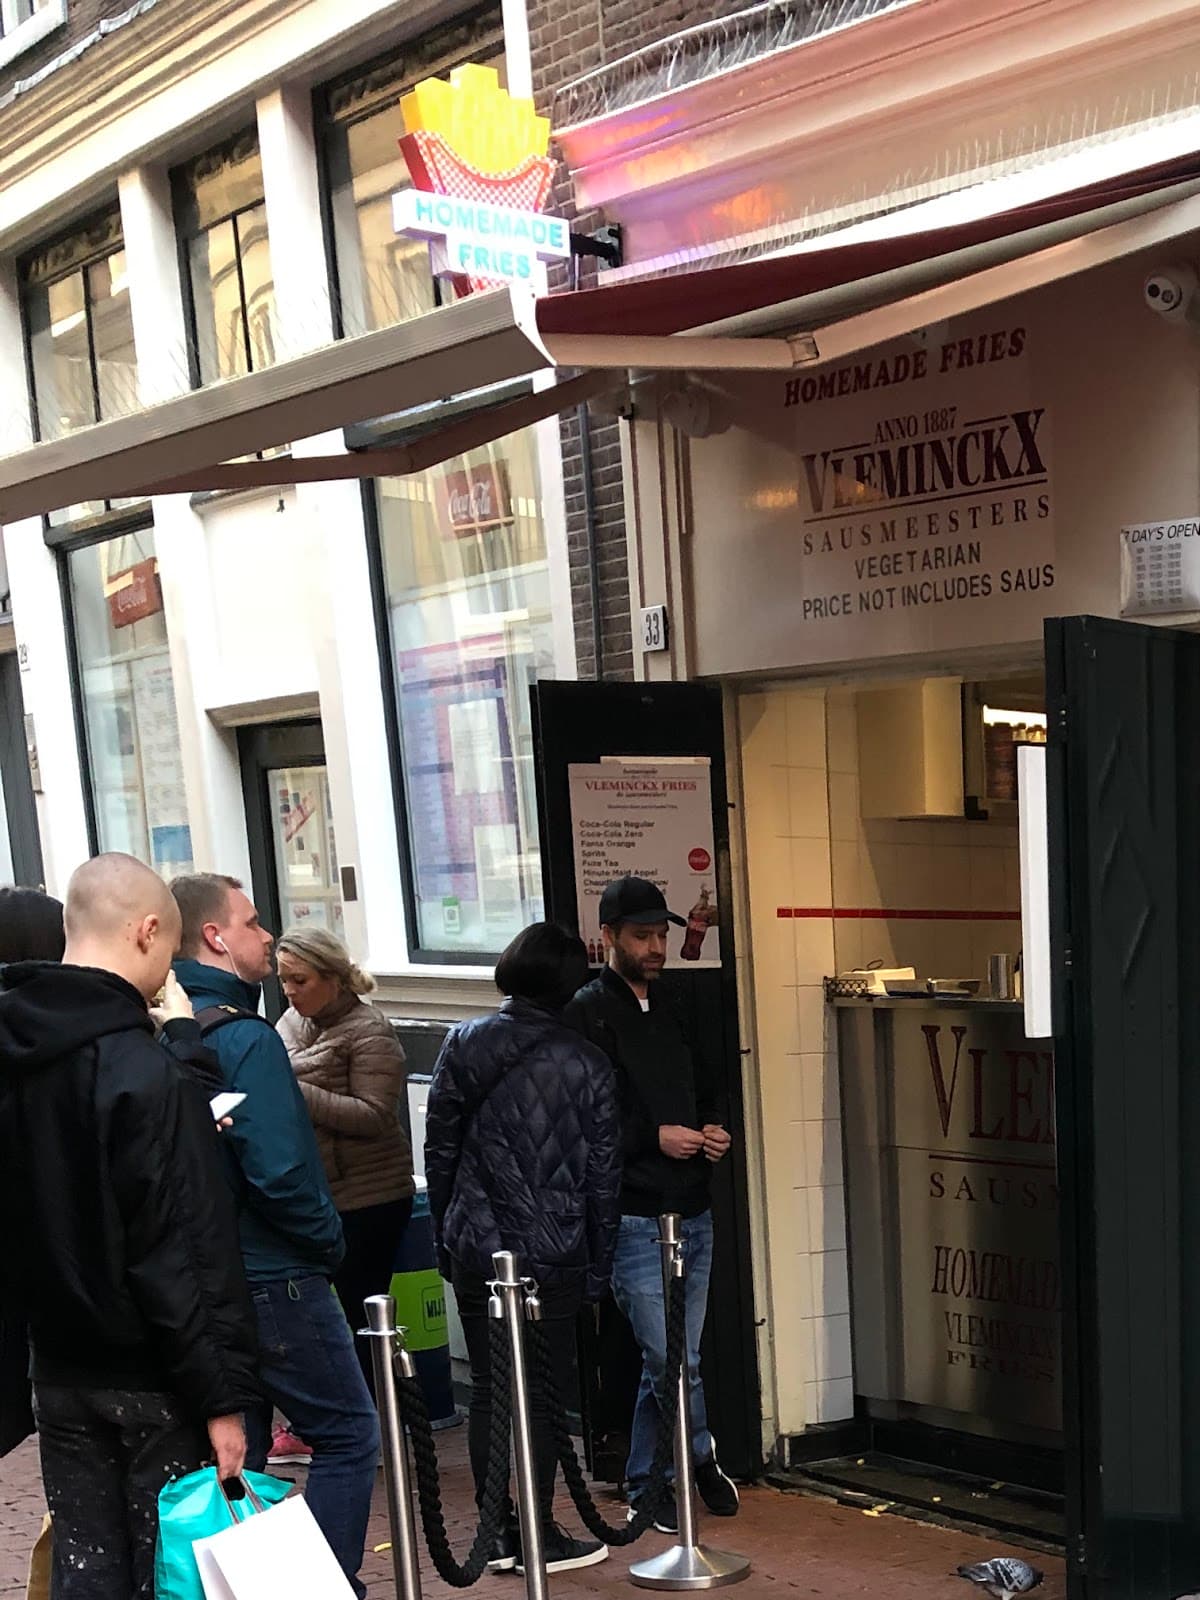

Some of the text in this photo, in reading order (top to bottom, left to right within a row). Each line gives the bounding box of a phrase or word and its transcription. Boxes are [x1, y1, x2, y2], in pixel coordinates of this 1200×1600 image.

[415, 197, 563, 249] HOMEMADE
[458, 242, 531, 279] FRIES
[784, 327, 1026, 407] HOMEMADE FRIES
[874, 406, 957, 445] ANNO 1887
[801, 408, 1047, 513] VLEMINCKX
[803, 495, 1049, 555] SAUSMEESTERS
[1131, 526, 1165, 543] DAY'S
[1167, 523, 1200, 539] OPEN
[855, 542, 981, 580] VEGETARIAN
[803, 564, 1054, 620] PRICE NOT INCLUDES SAUS
[645, 613, 660, 646] 33
[585, 781, 697, 791] VLEMINCKX FRIES
[579, 820, 655, 829] Coca-Cola Regular
[580, 829, 644, 838] Coca-Cola Zero
[581, 840, 636, 848] Fanta Orange
[581, 850, 606, 858] Sprite
[583, 869, 610, 877] Minute
[634, 868, 658, 877] Appel
[920, 1025, 1055, 1144] VLE
